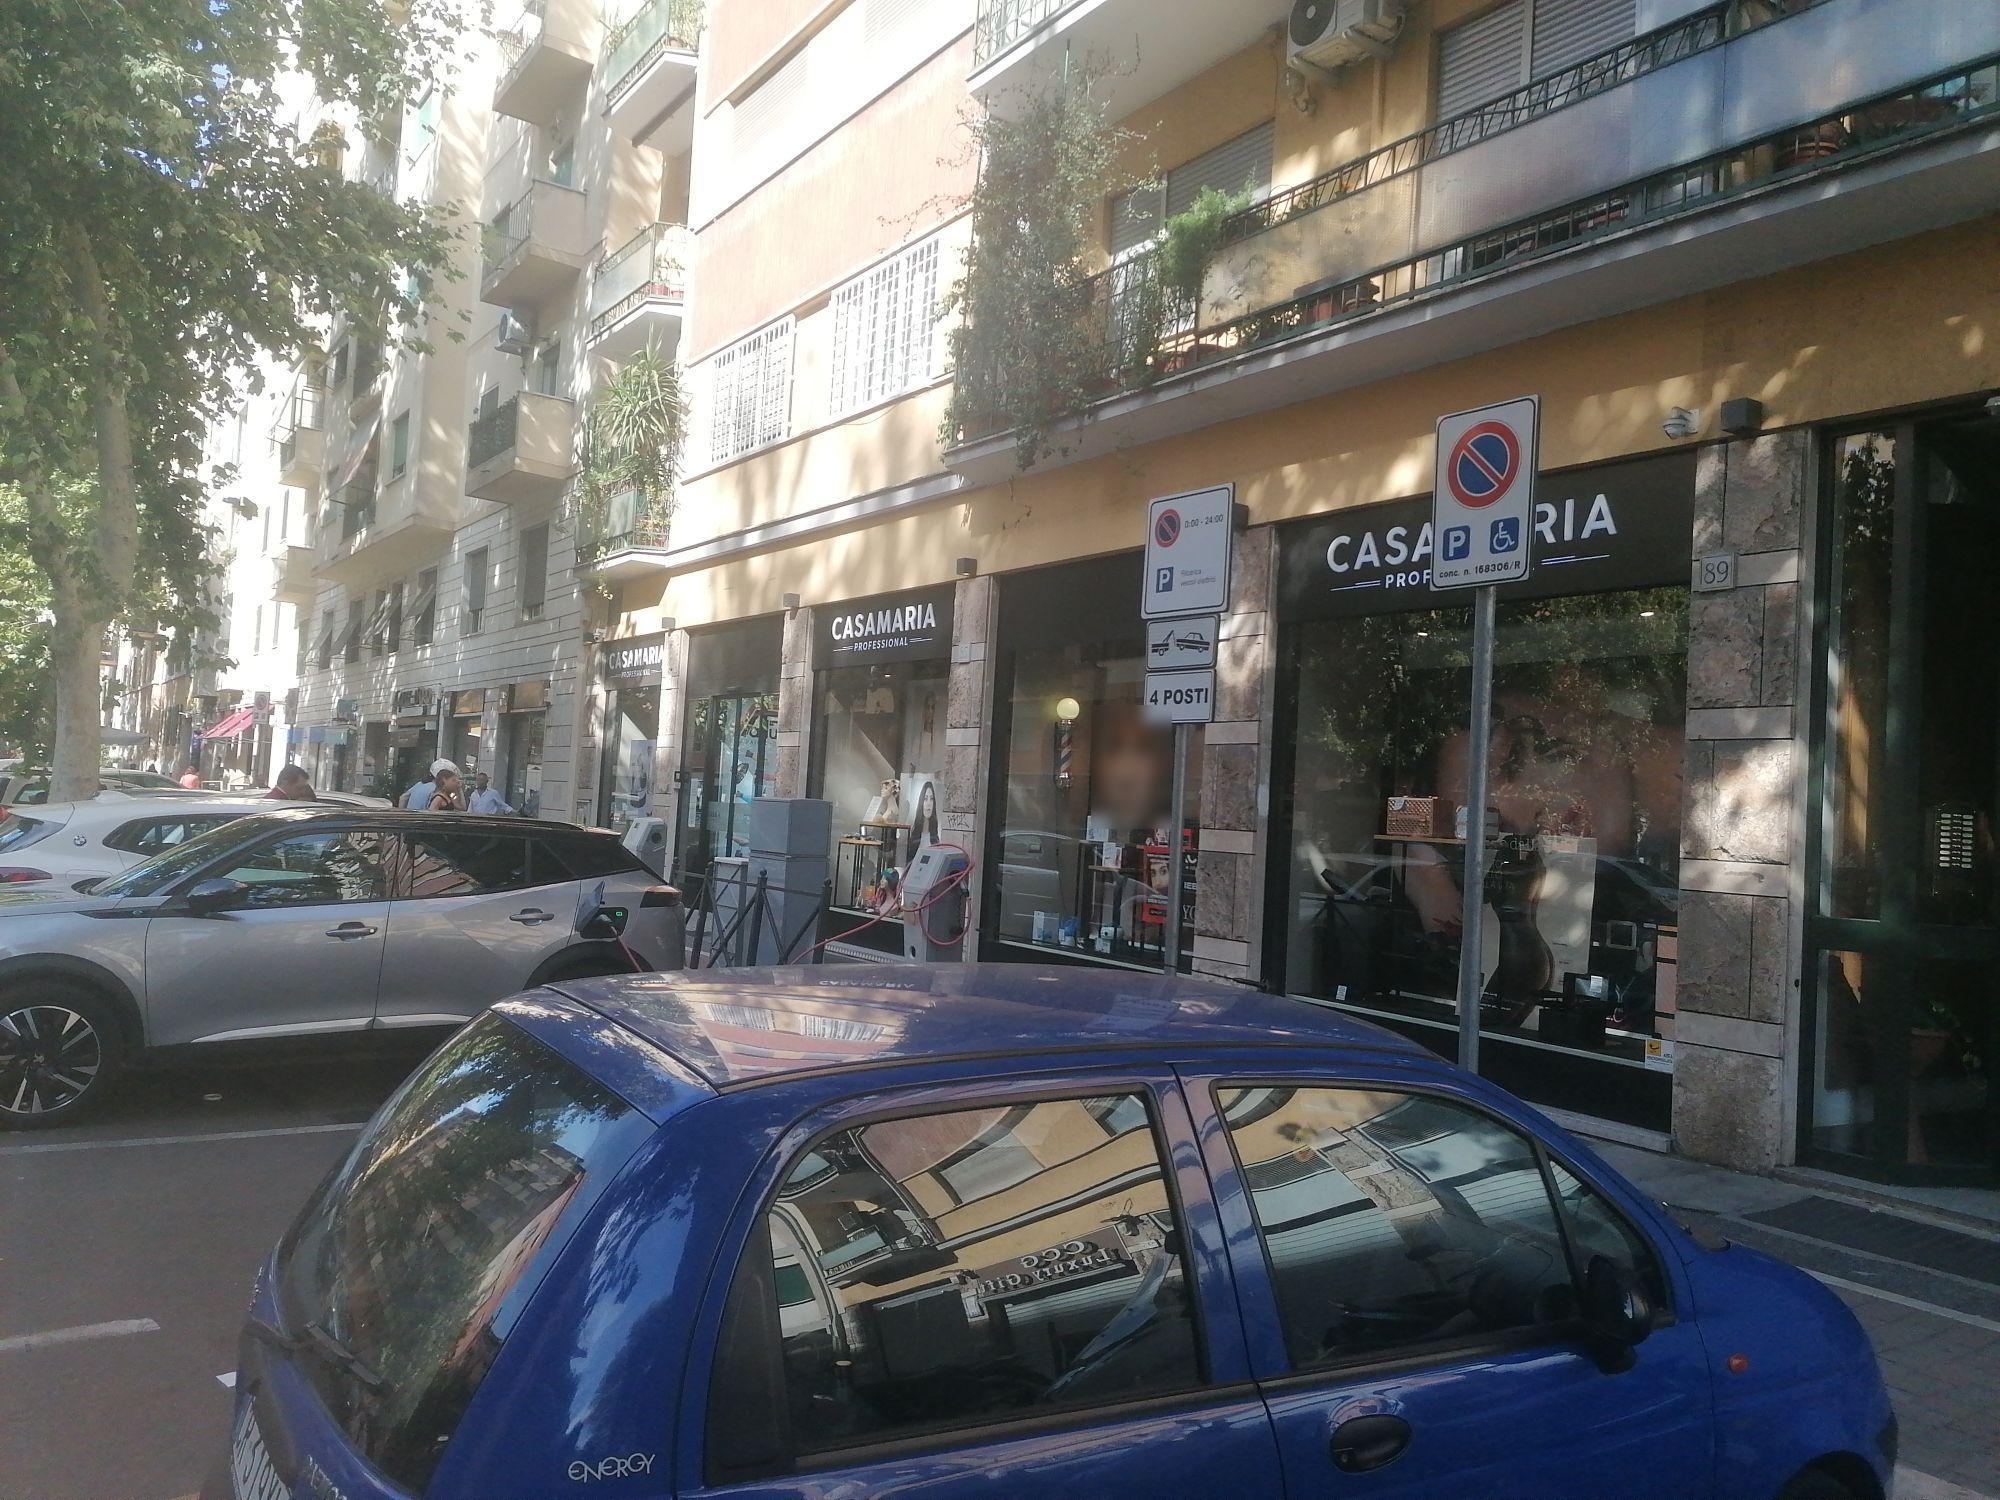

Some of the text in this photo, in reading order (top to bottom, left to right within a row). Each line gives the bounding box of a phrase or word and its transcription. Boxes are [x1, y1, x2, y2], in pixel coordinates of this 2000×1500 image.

[1327, 494, 1618, 573] CASARIA
[1448, 529, 1466, 558] P
[1158, 569, 1171, 591] P
[1704, 561, 1729, 584] 89
[831, 602, 937, 641] CASAMARIA
[853, 636, 909, 652] PROFESSIONAL
[1149, 687, 1209, 705] 4 POSTI
[567, 1452, 656, 1484] ENERGY
